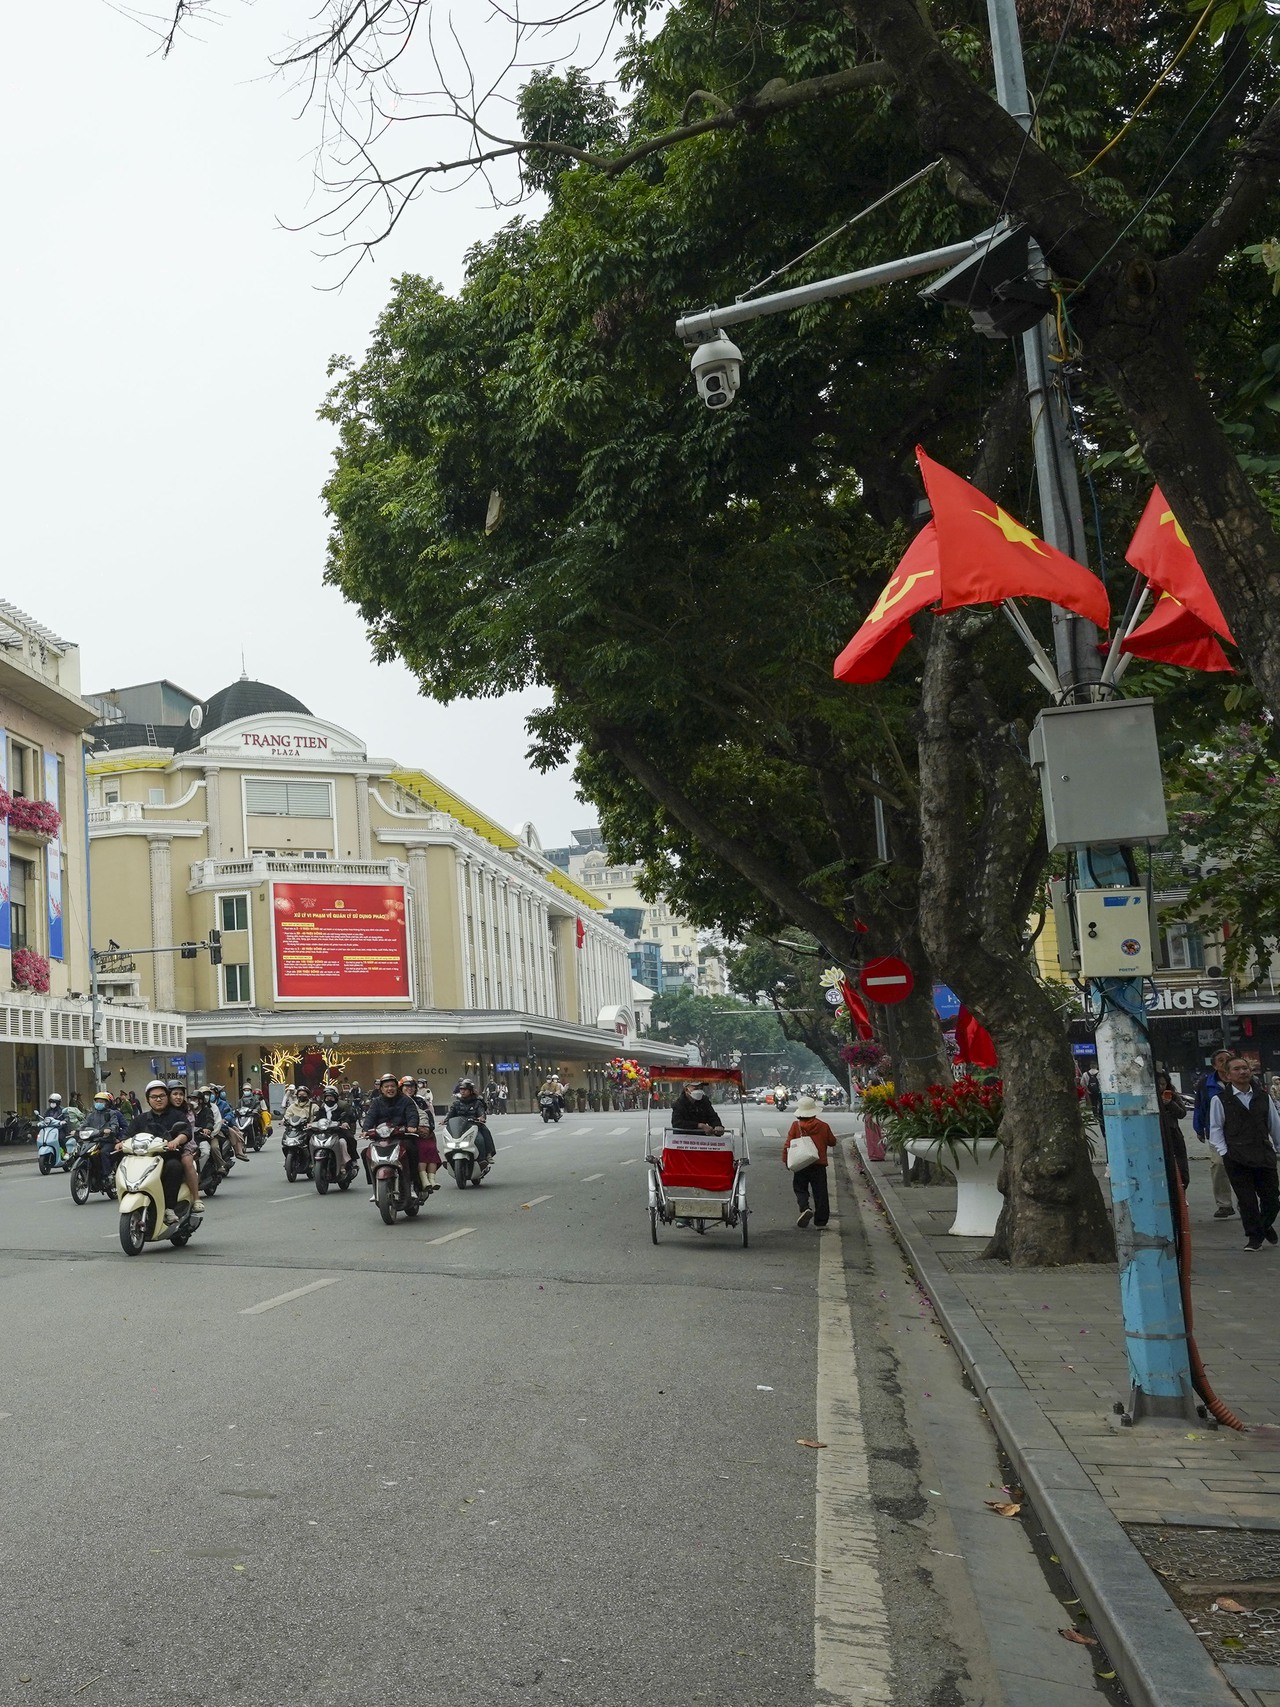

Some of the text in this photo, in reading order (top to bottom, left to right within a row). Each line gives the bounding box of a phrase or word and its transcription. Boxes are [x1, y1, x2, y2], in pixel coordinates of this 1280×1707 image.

[242, 733, 328, 749] TRANG TIEN
[1144, 988, 1219, 1011] ald's
